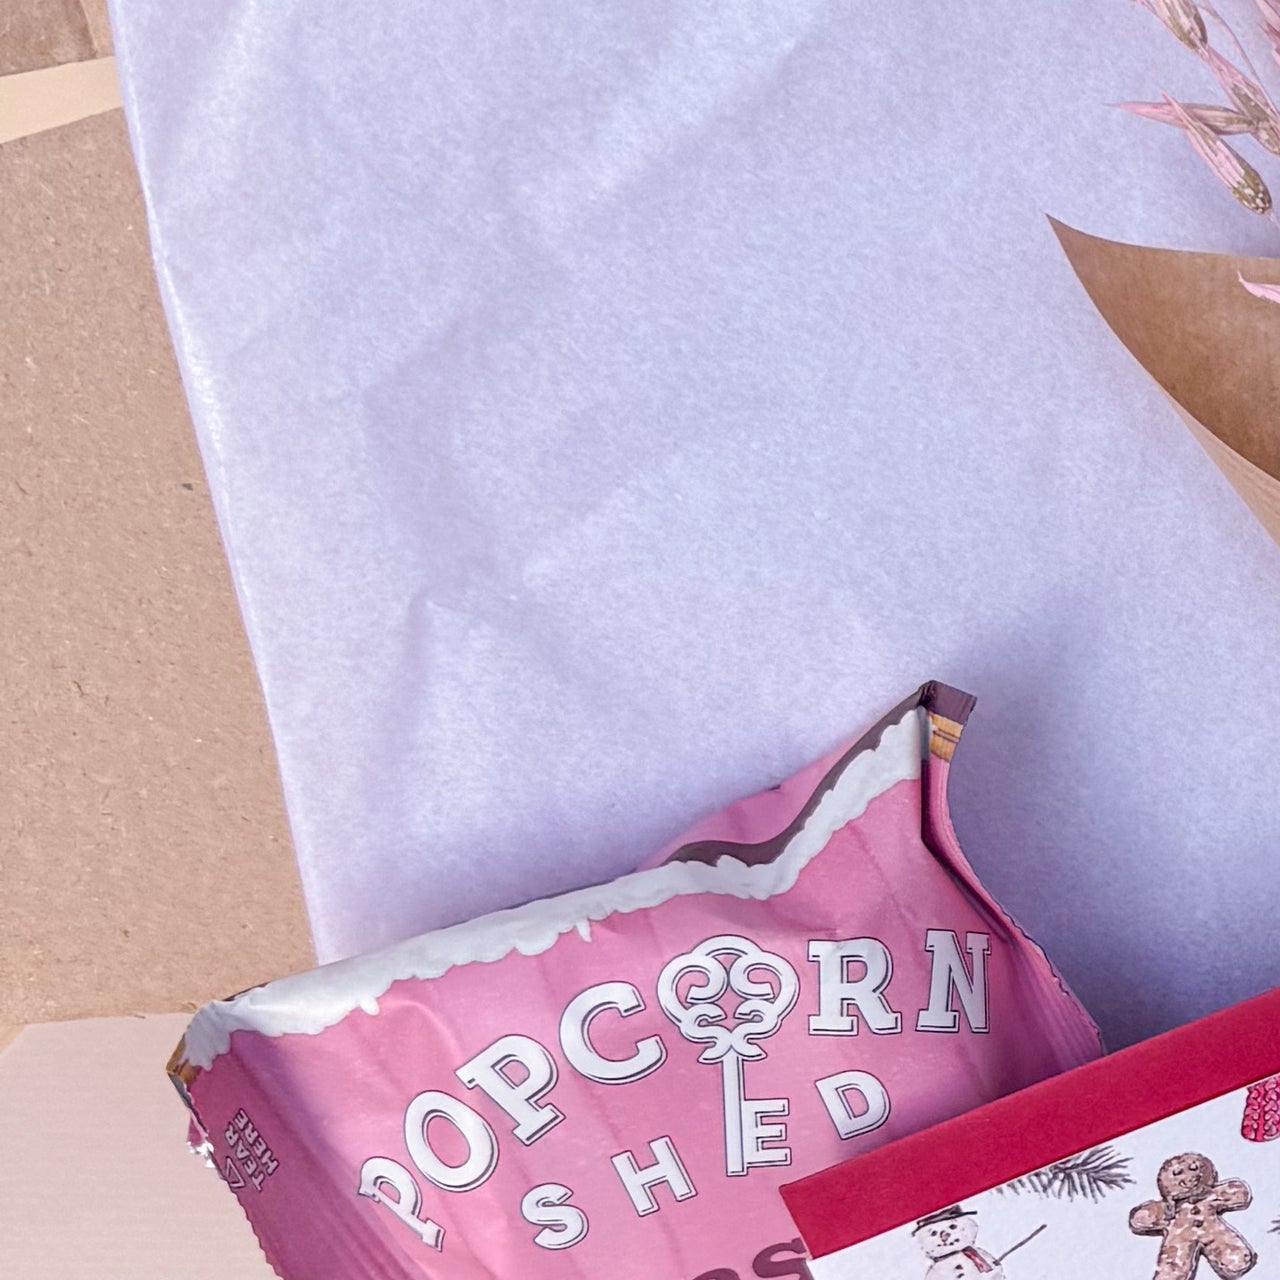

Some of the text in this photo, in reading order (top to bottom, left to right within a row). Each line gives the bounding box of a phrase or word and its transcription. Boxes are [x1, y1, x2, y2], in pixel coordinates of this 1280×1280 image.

[225, 1122, 265, 1192] TEAR
[234, 1108, 279, 1175] HERE
[520, 1069, 891, 1251] SHED
